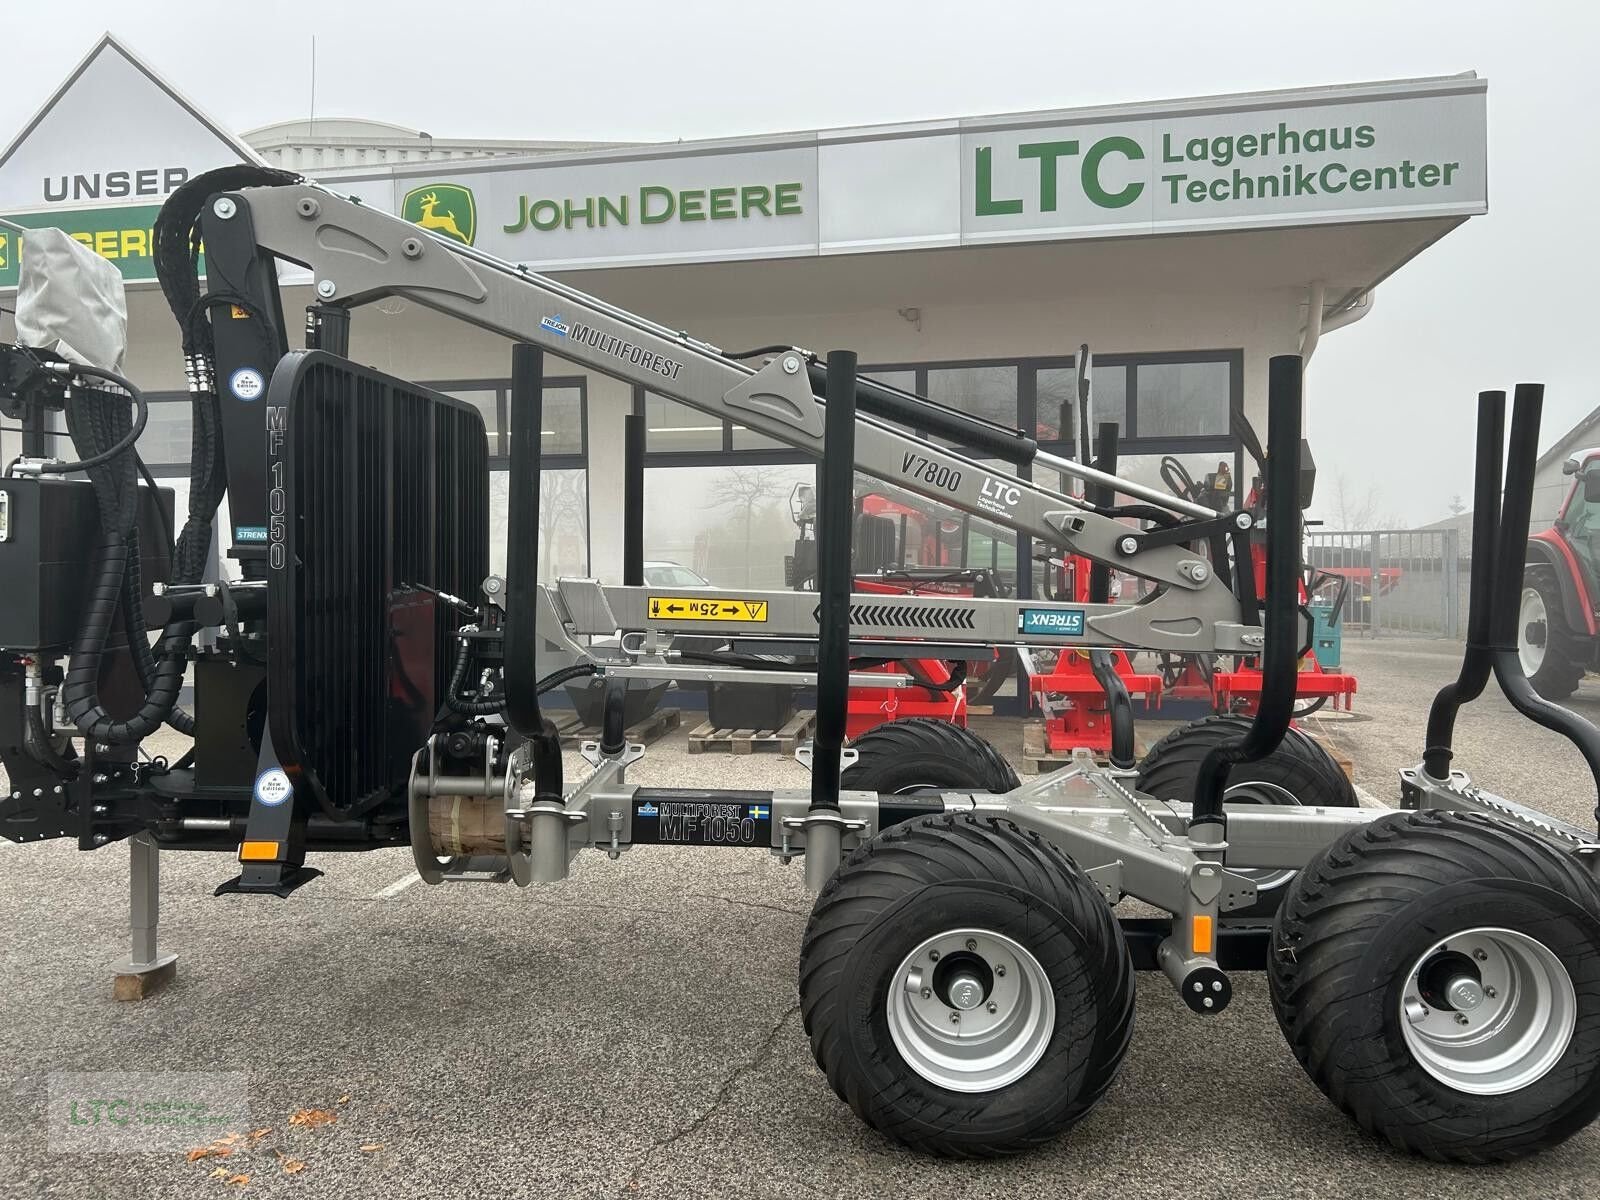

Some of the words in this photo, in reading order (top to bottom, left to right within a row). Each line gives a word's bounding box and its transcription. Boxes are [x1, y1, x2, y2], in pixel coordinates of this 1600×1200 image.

[1162, 122, 1376, 167] Lagerhaus
[975, 136, 1145, 217] LTC
[1161, 159, 1459, 204] TechnikCenter
[503, 195, 629, 233] JOHN
[640, 182, 803, 225] DEERE
[543, 317, 568, 332] TREJON
[571, 323, 684, 380] MULTIFOREST
[981, 477, 1021, 506] LTC
[659, 802, 742, 818] MULTIFOREST
[659, 816, 698, 841] MF
[701, 816, 756, 843] 1050
